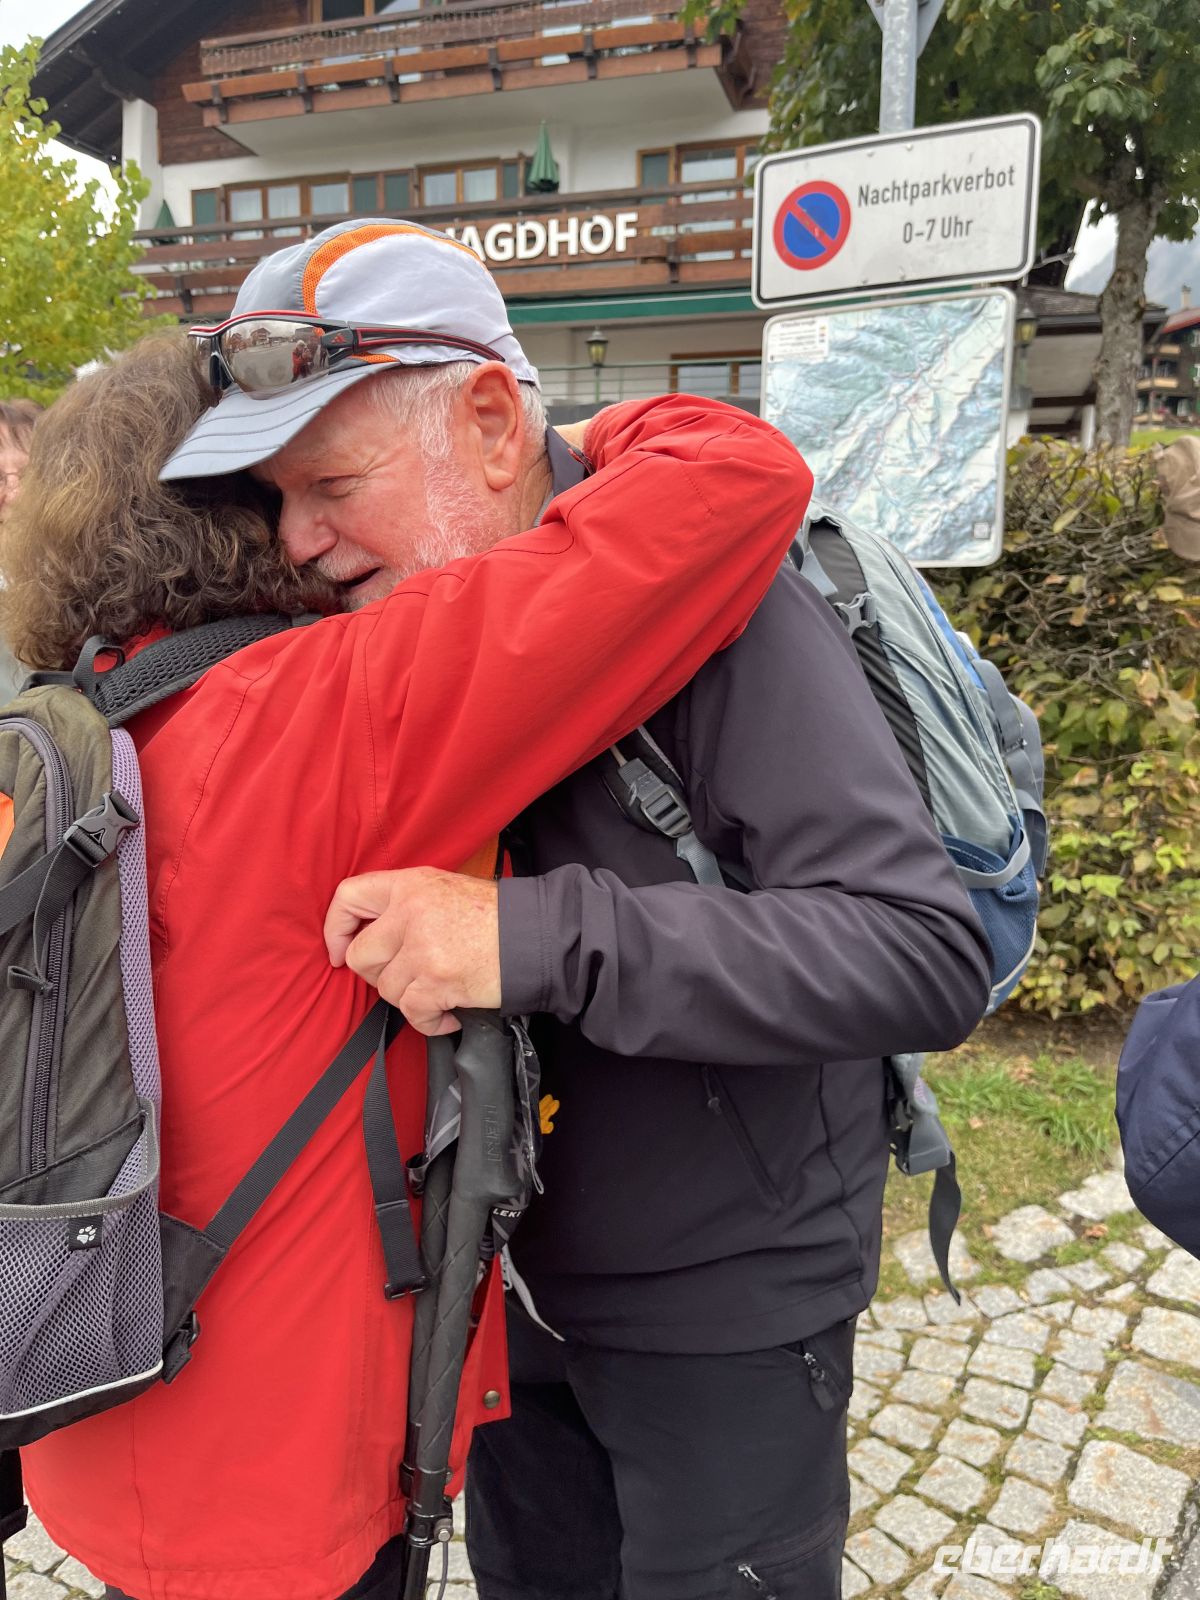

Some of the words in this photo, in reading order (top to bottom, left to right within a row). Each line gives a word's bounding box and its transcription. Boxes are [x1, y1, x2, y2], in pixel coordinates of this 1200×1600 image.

[858, 165, 1015, 208] Nachtparkverbot
[940, 215, 974, 239] Uhr
[492, 1206, 522, 1218] LEKI
